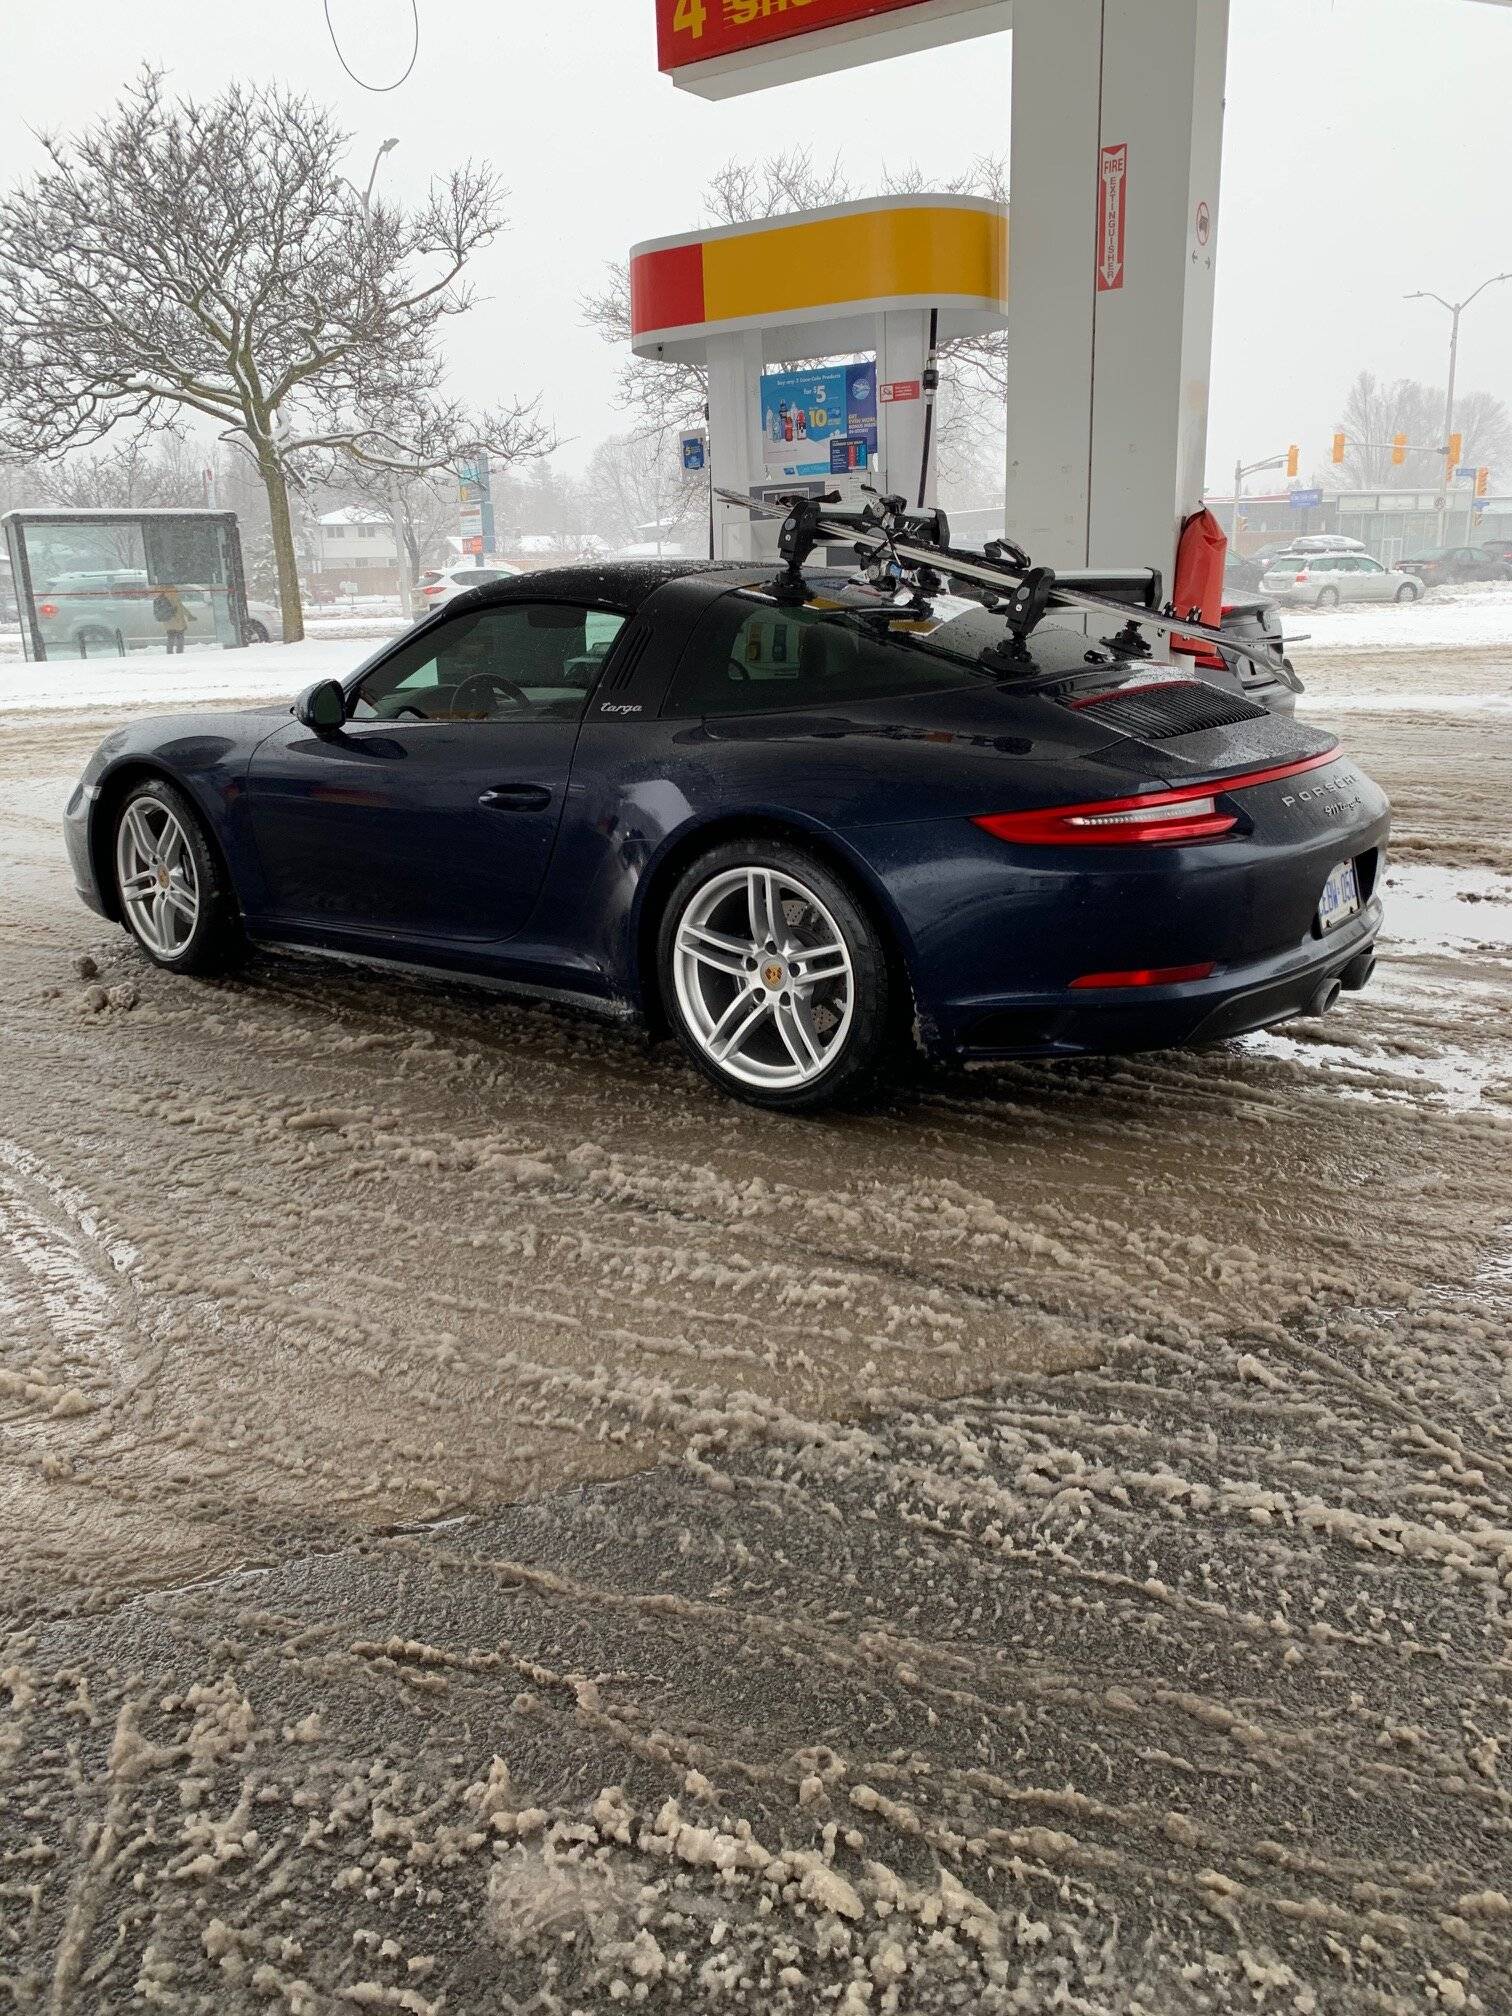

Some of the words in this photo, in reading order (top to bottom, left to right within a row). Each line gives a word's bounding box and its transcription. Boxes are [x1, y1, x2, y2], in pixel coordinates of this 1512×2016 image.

[673, 0, 706, 38] 4
[1104, 158, 1123, 174] FIRE
[1107, 176, 1116, 279] EXTINGUISHER
[809, 409, 828, 428] 10
